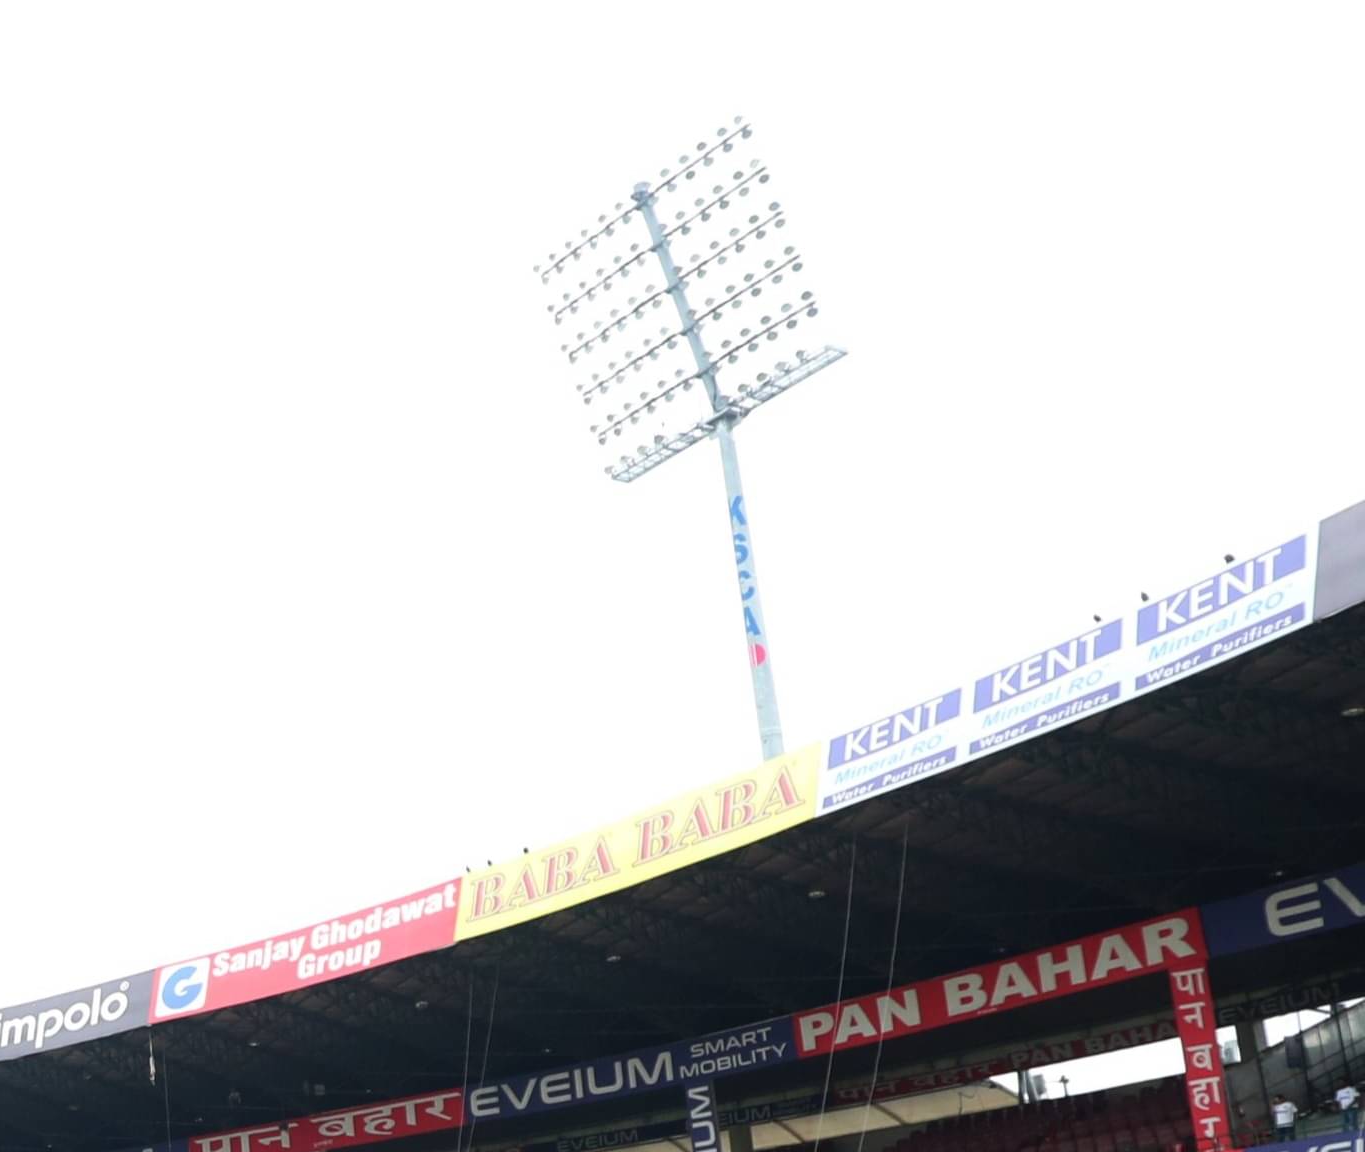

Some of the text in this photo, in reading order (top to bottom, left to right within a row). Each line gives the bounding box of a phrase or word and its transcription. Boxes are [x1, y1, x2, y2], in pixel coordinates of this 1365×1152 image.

[730, 494, 761, 637] KSCA
[1156, 549, 1282, 630] KENT
[1146, 614, 1293, 686] Water Purifiers
[1149, 590, 1285, 663] Mineral RO
[983, 668, 1103, 729] Mineral RO
[991, 629, 1102, 701] KENT
[844, 696, 944, 761] KENT
[980, 691, 1109, 748] Water Purifiers
[832, 754, 948, 803] Water Purifiers
[834, 733, 942, 786] Mineral RO
[468, 766, 806, 923] BABA BABA
[212, 885, 458, 976] Sanjay Ghodawat
[297, 940, 381, 981] Group
[799, 916, 1196, 1053] PAN BAHAR
[679, 1043, 787, 1079] MOBILITY
[689, 1026, 771, 1059] SMART
[471, 1051, 674, 1118] EVEIUM
